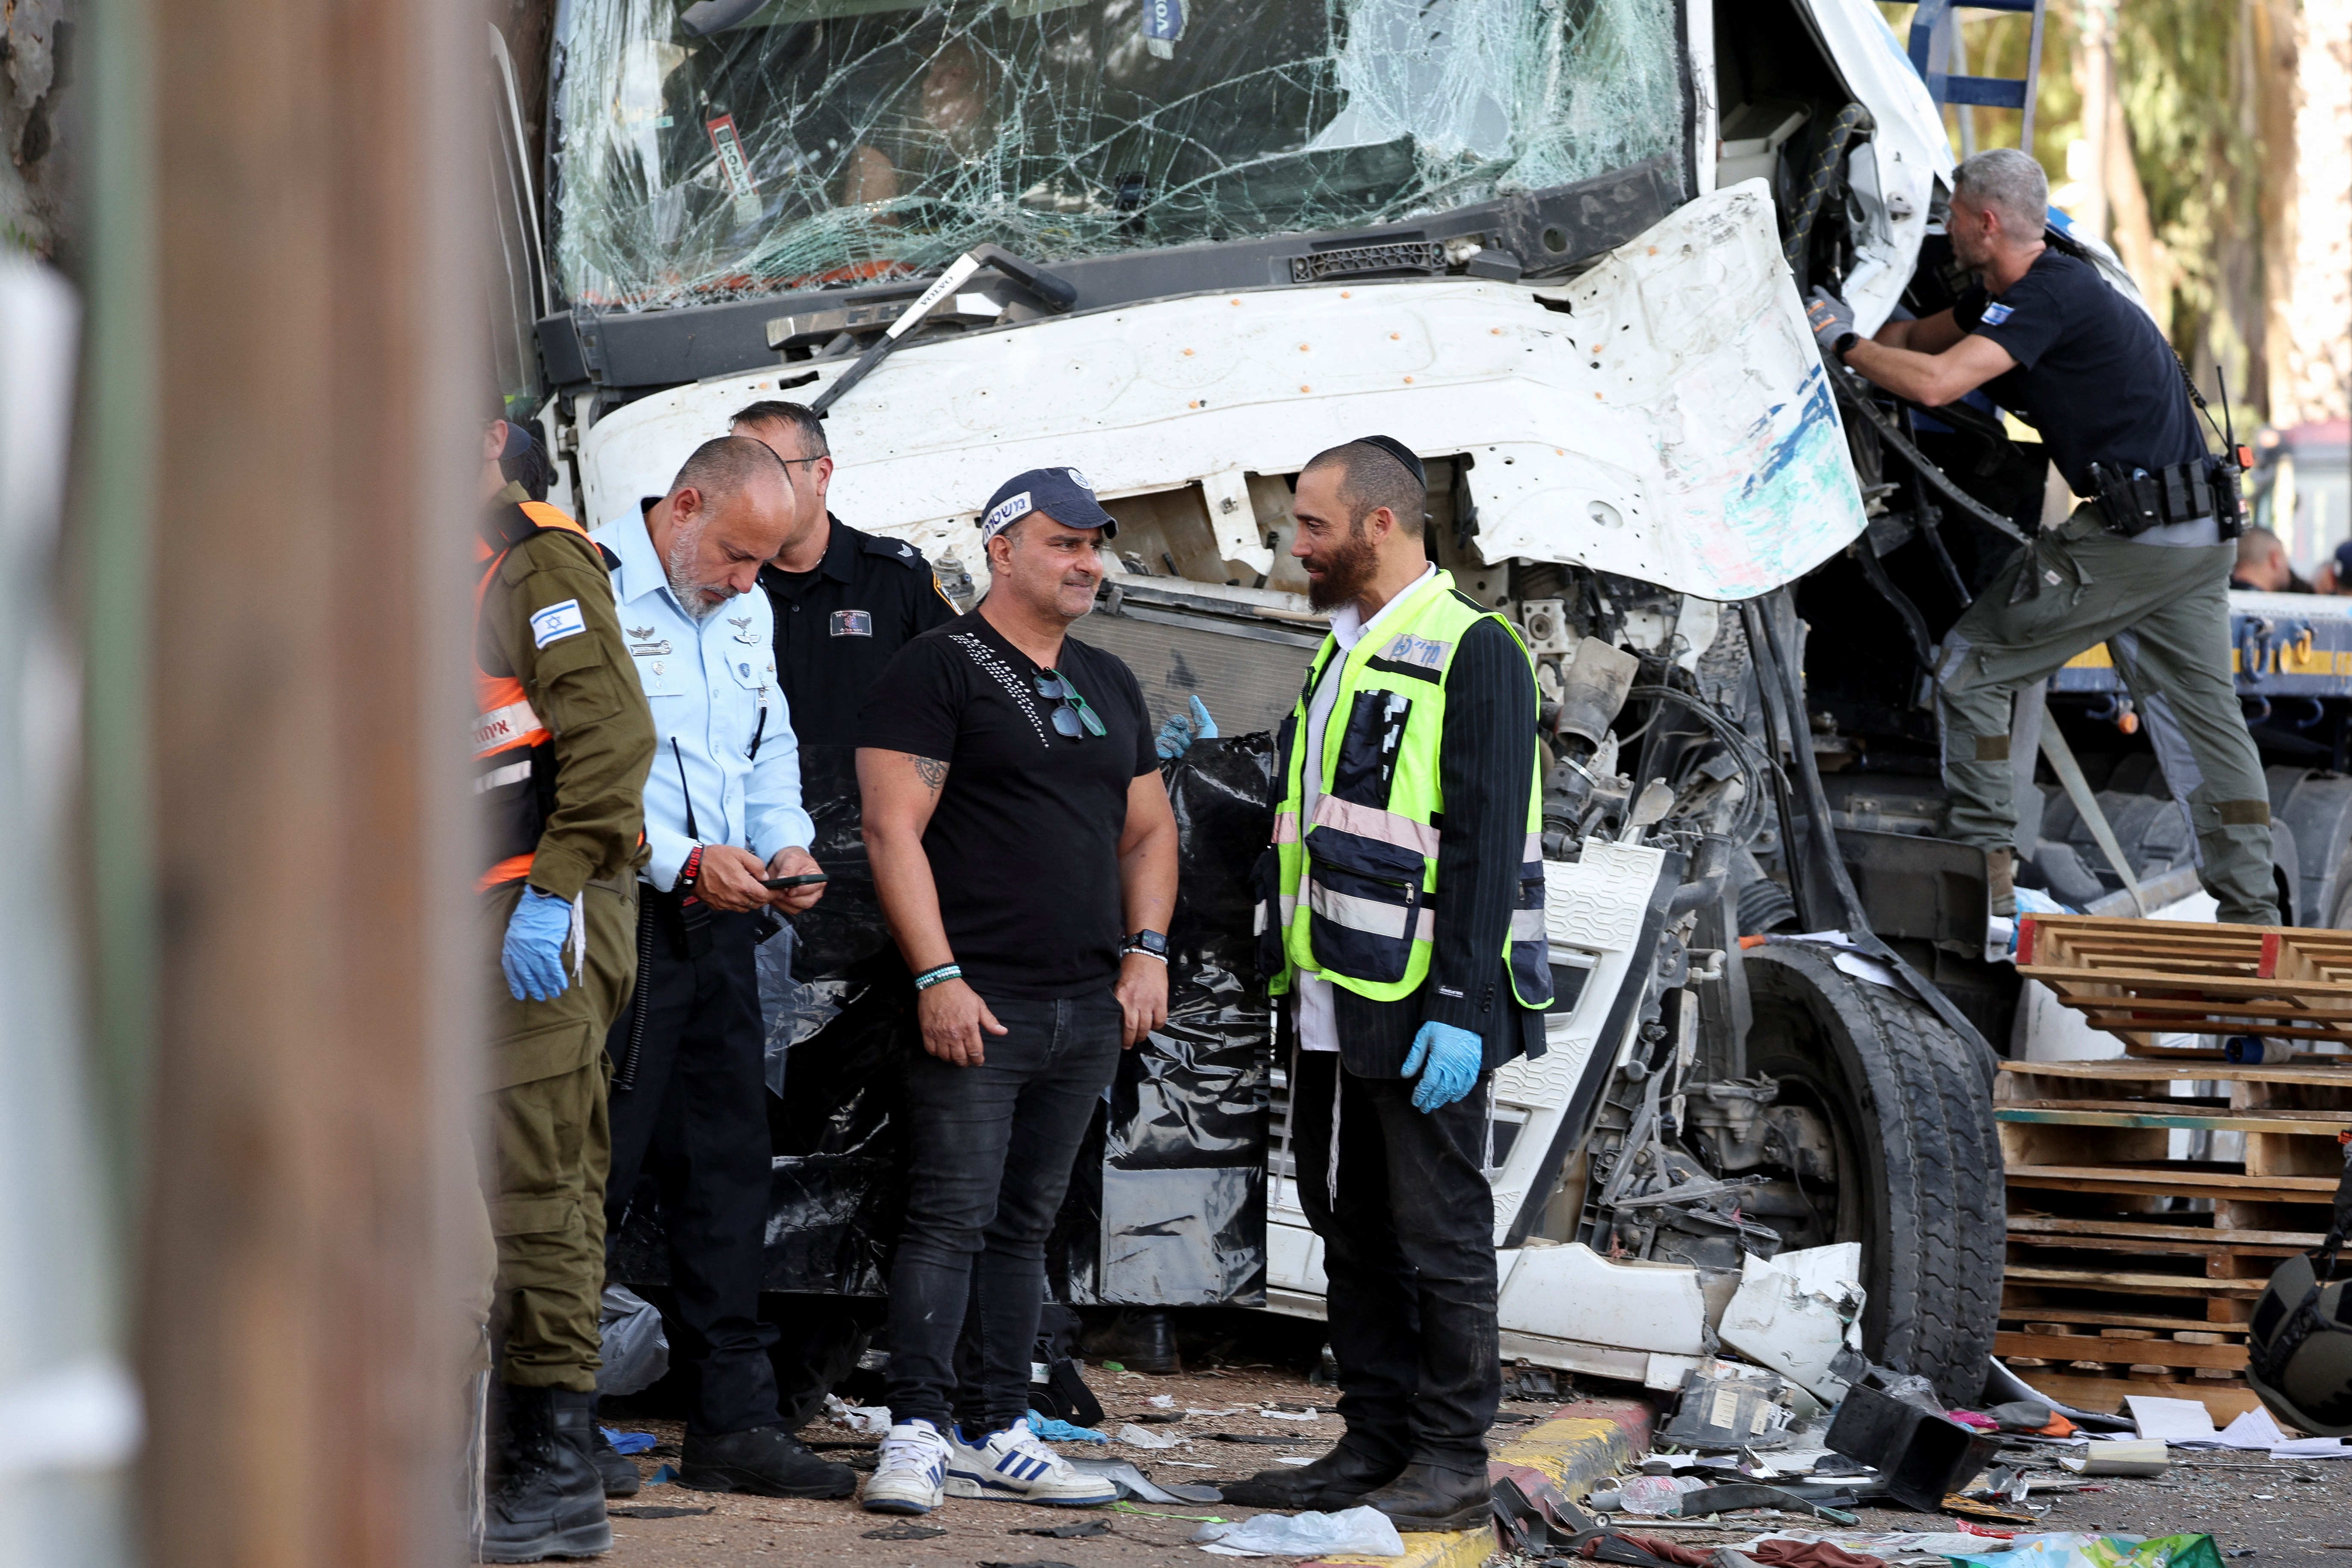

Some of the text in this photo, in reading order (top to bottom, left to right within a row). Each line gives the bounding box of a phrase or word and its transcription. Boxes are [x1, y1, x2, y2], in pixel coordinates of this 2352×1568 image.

[1155, 0, 1168, 34] VO
[921, 276, 953, 305] VOLVO
[987, 663, 1026, 702] PORTOBELLO
[1027, 706, 1042, 724] ROAD
[992, 662, 1013, 681] DENIM
[1014, 685, 1034, 706] BRAND
[999, 661, 1031, 693] JEANS
[1004, 686, 1016, 697] FOR
[1017, 701, 1049, 747] EXCELLENCE
